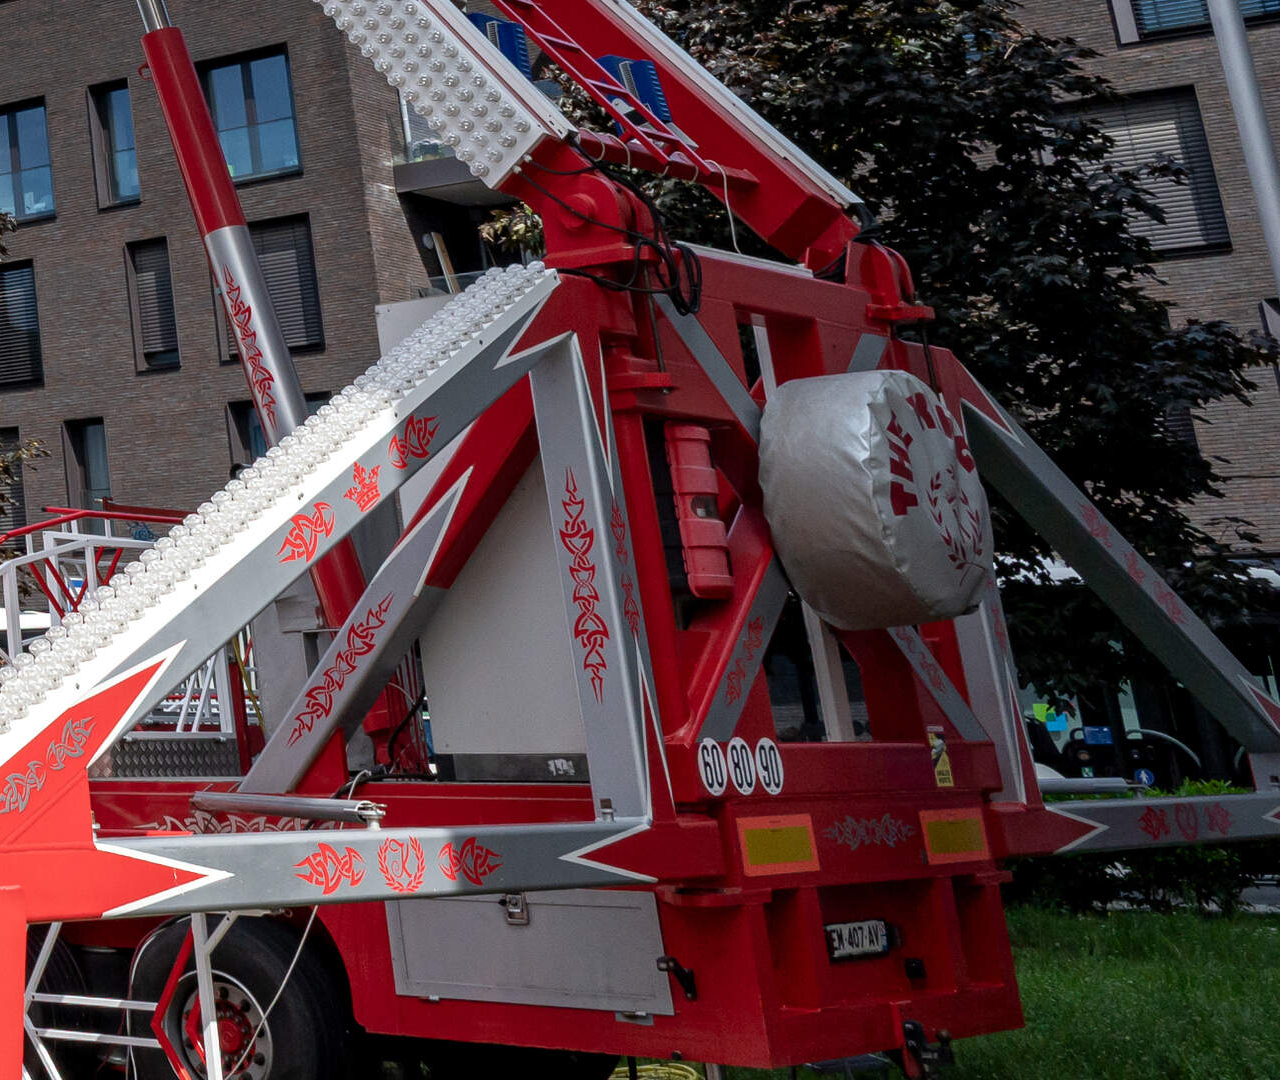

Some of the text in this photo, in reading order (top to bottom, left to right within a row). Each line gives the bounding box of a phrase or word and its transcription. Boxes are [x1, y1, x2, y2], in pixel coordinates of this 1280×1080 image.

[701, 744, 724, 788] 60
[730, 743, 753, 789] 80
[759, 744, 781, 789] 90
